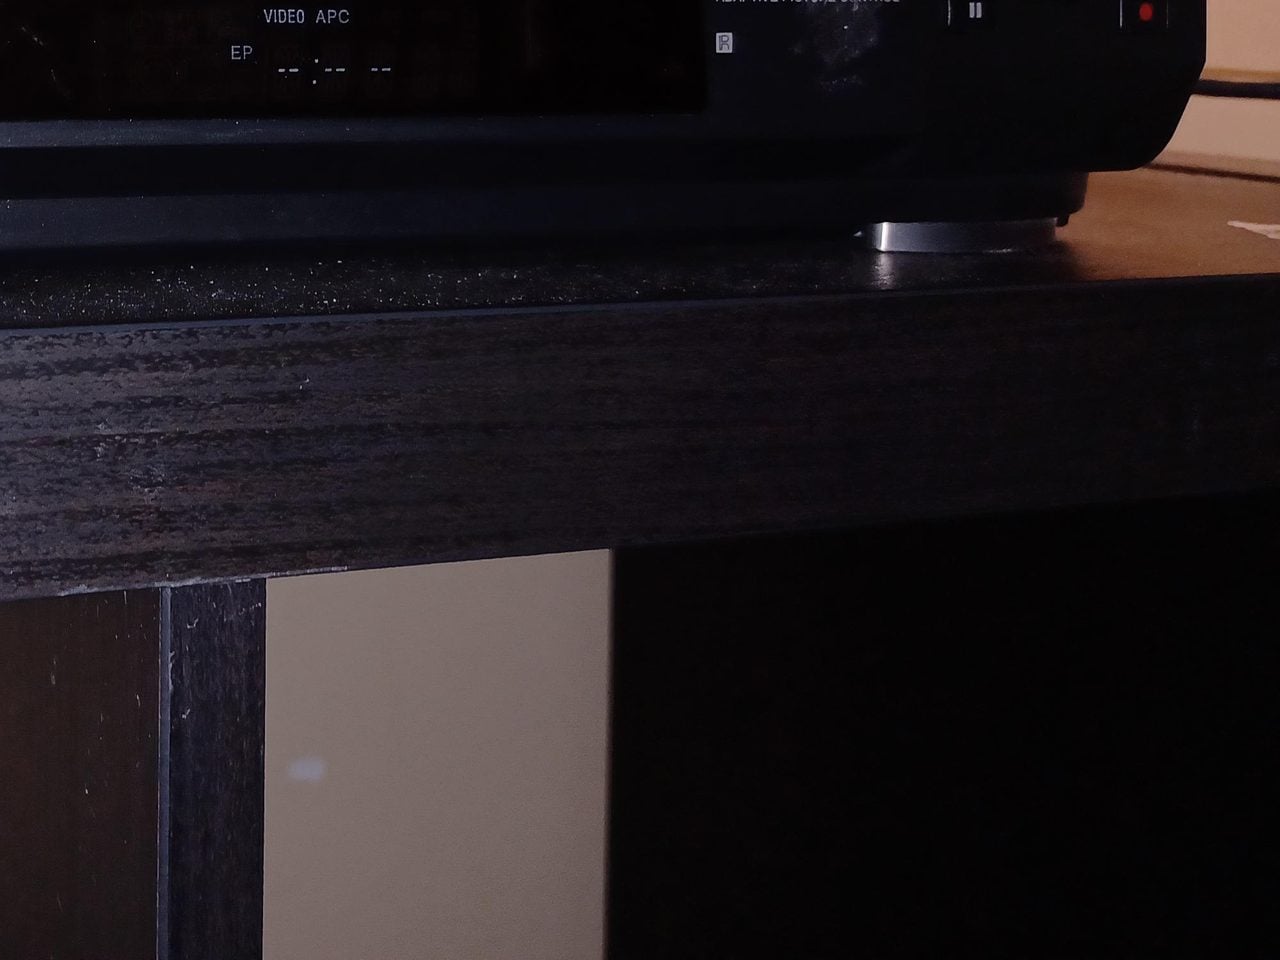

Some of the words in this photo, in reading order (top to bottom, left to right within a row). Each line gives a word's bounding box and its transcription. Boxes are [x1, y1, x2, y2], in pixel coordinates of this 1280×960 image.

[263, 8, 305, 24] VIDEO
[315, 9, 350, 24] APC
[231, 45, 253, 60] EP
